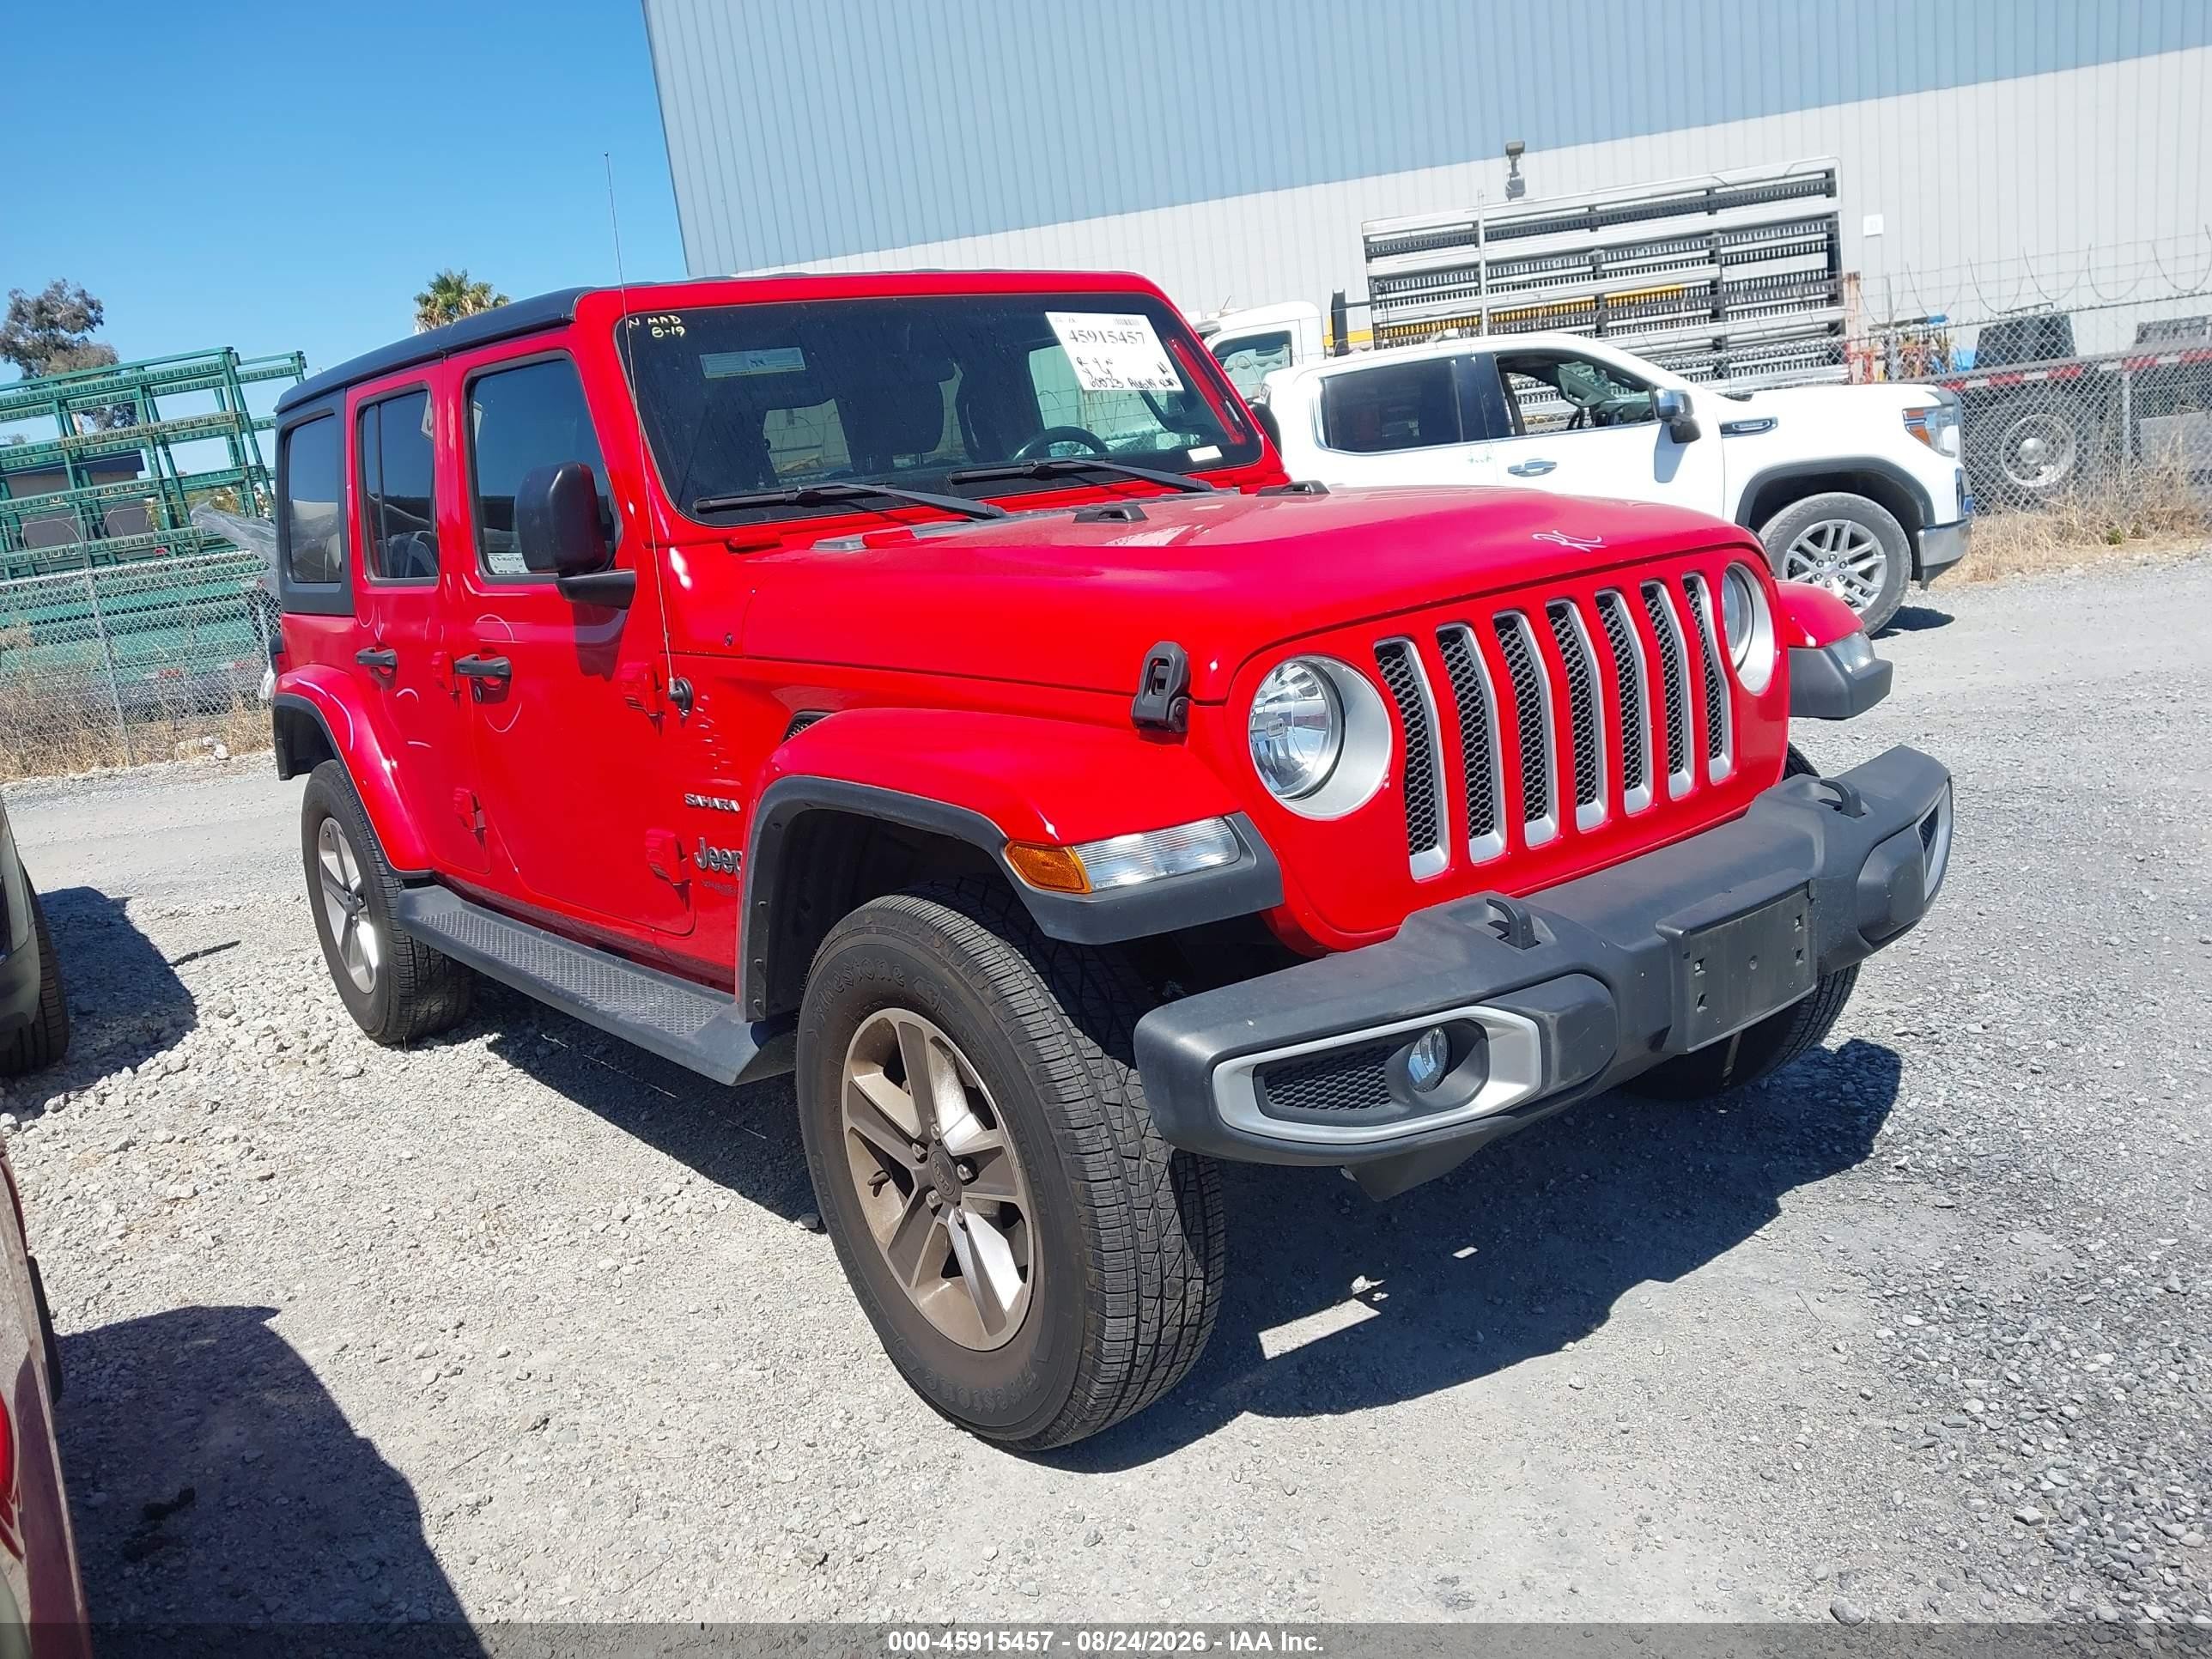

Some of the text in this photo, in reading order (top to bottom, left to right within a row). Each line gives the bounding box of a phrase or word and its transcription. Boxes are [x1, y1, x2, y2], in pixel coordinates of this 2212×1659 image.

[652, 326, 685, 338] 8-19
[1069, 330, 1145, 344] 45915457
[684, 793, 741, 812] SAHARA
